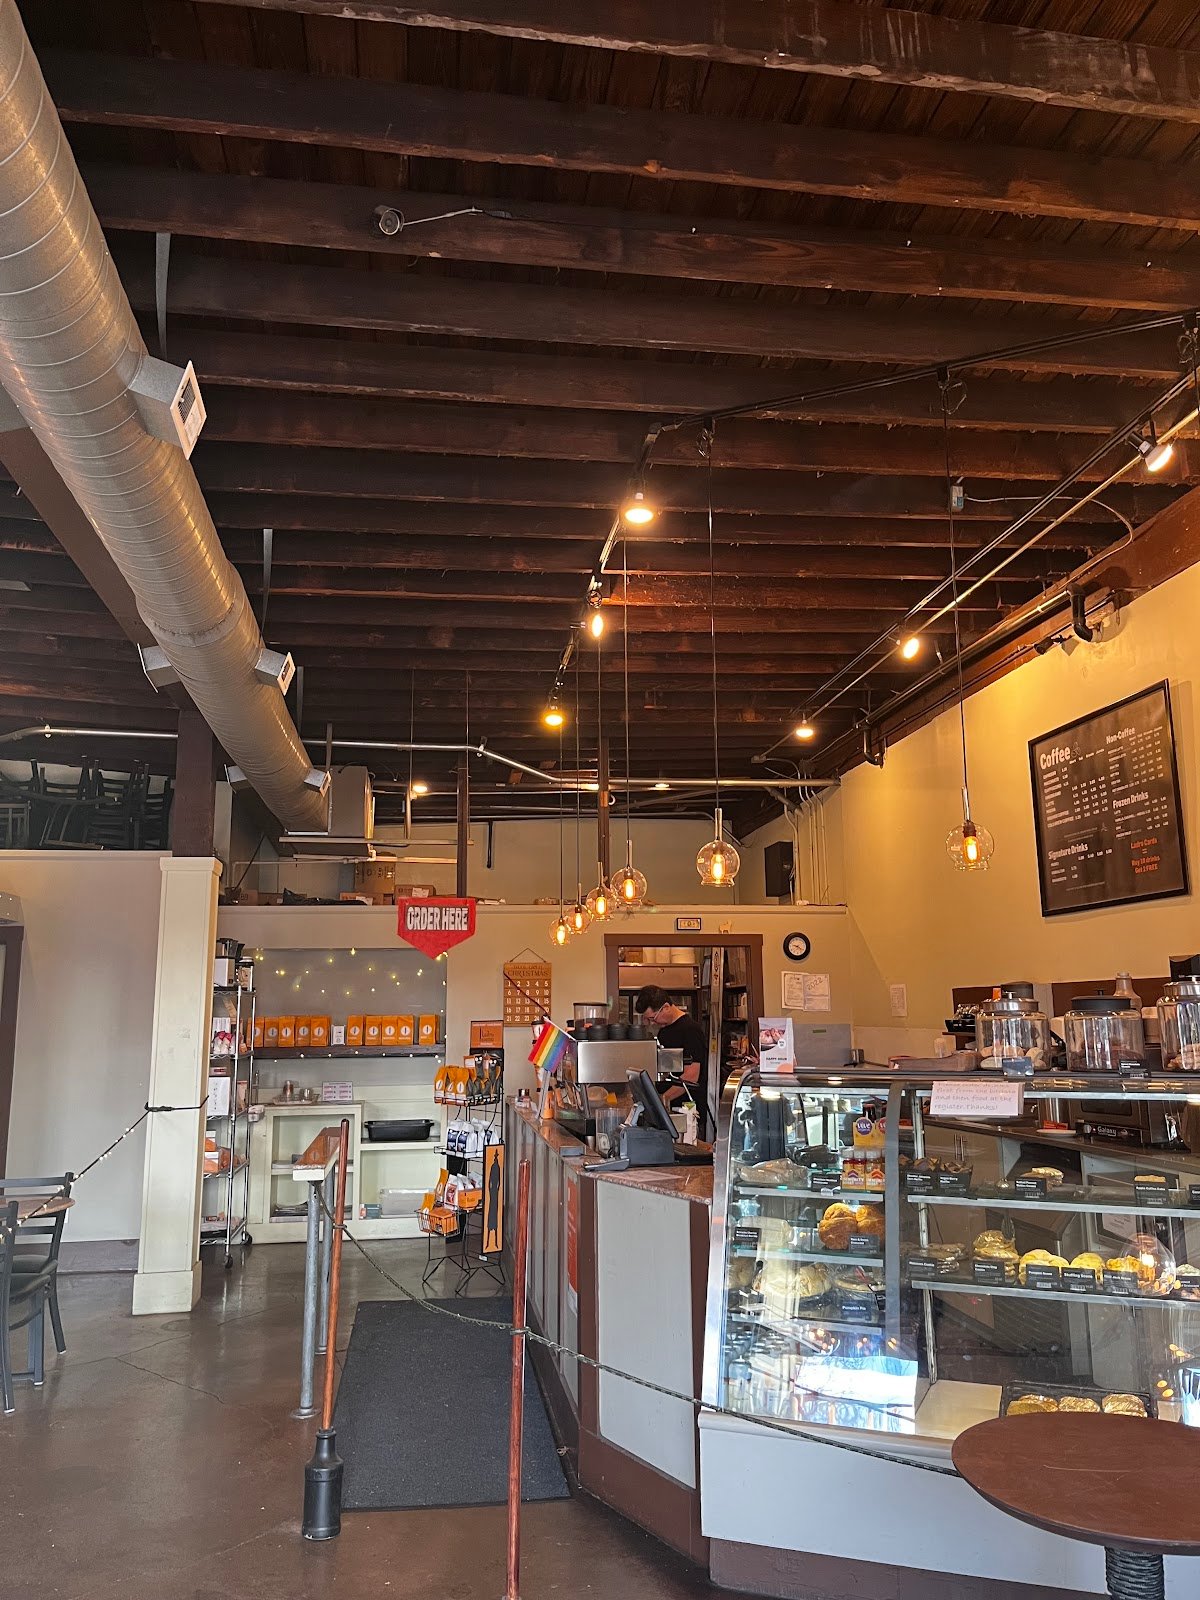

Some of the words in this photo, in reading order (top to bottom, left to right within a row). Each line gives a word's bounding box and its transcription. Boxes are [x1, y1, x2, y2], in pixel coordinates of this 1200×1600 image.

[1106, 728, 1135, 744] Non-Coffee
[1040, 747, 1071, 769] Coffee
[1112, 797, 1131, 809] Frozen
[1131, 791, 1149, 804] Drinks
[1048, 847, 1071, 860] Signature
[1071, 842, 1089, 854] Drinks
[407, 906, 440, 931] ORDER
[441, 907, 469, 931] HERE
[1097, 1126, 1117, 1136] Galaxy
